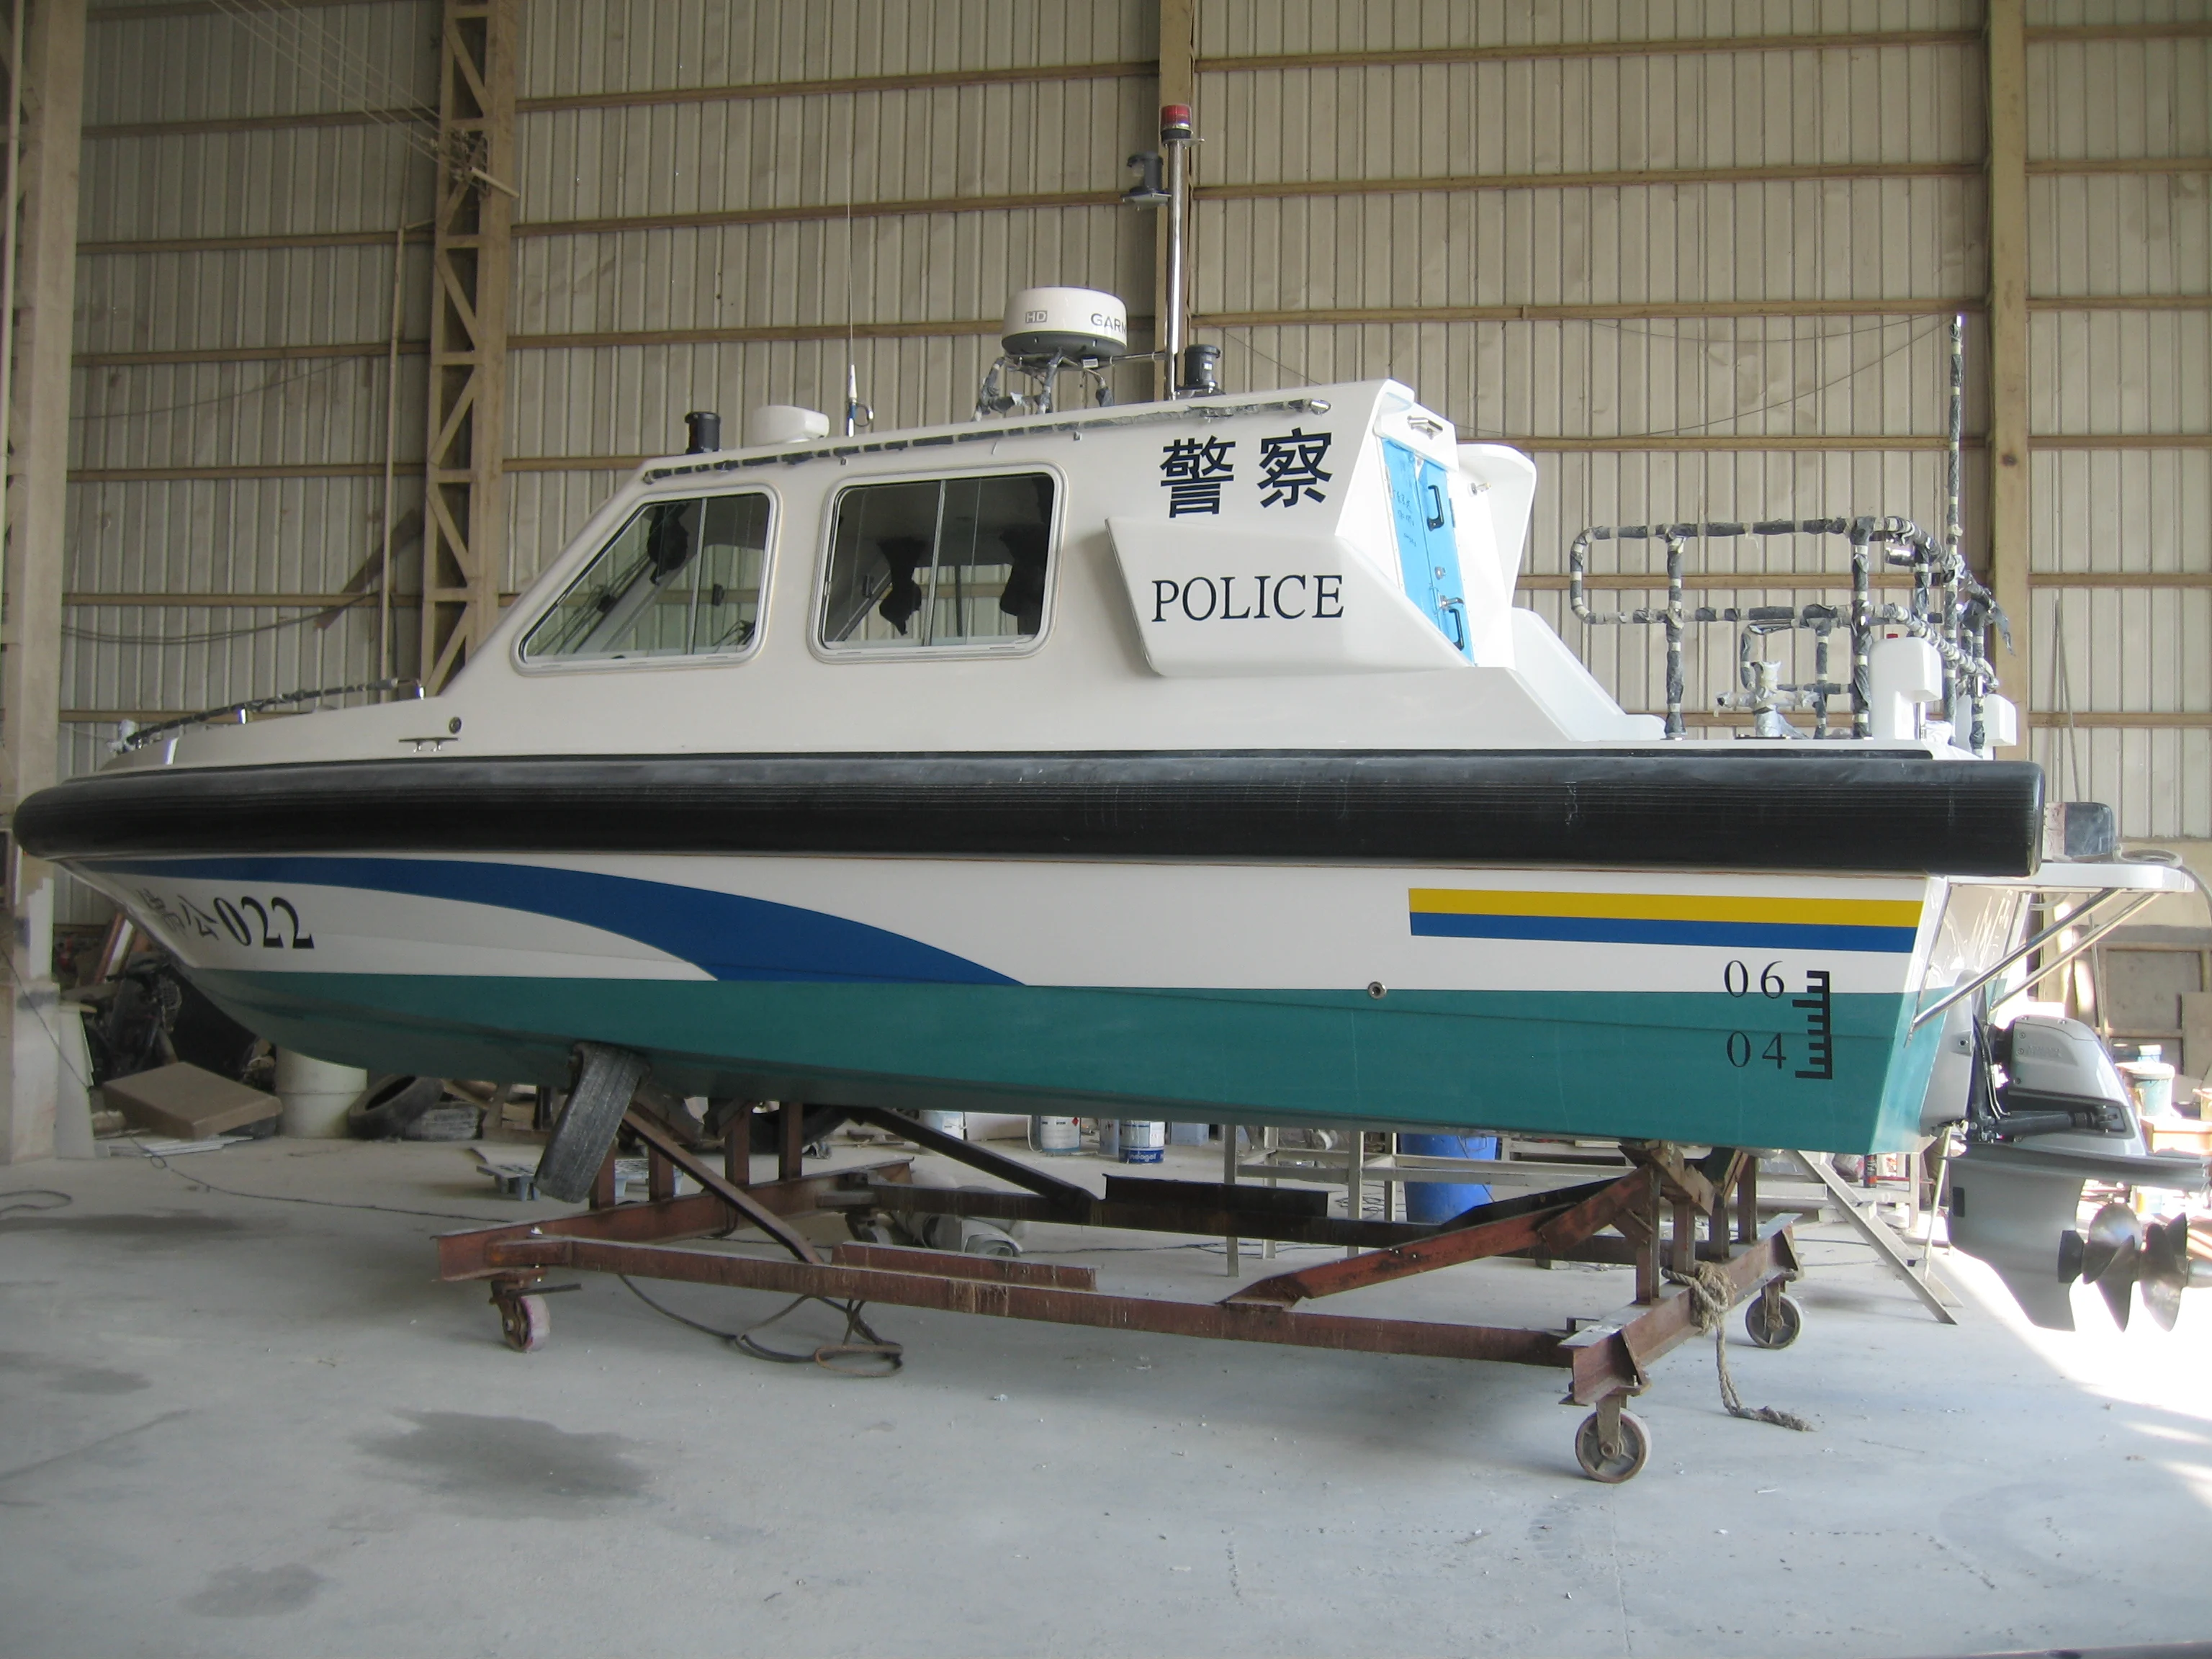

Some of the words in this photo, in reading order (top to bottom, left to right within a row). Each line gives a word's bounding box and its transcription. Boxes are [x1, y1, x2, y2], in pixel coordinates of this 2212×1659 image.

[1025, 310, 1047, 323] HD
[1159, 427, 1332, 518] 警察
[1151, 575, 1344, 622] POLICE
[1724, 960, 1784, 999] 06
[1726, 1030, 1786, 1069] 04
